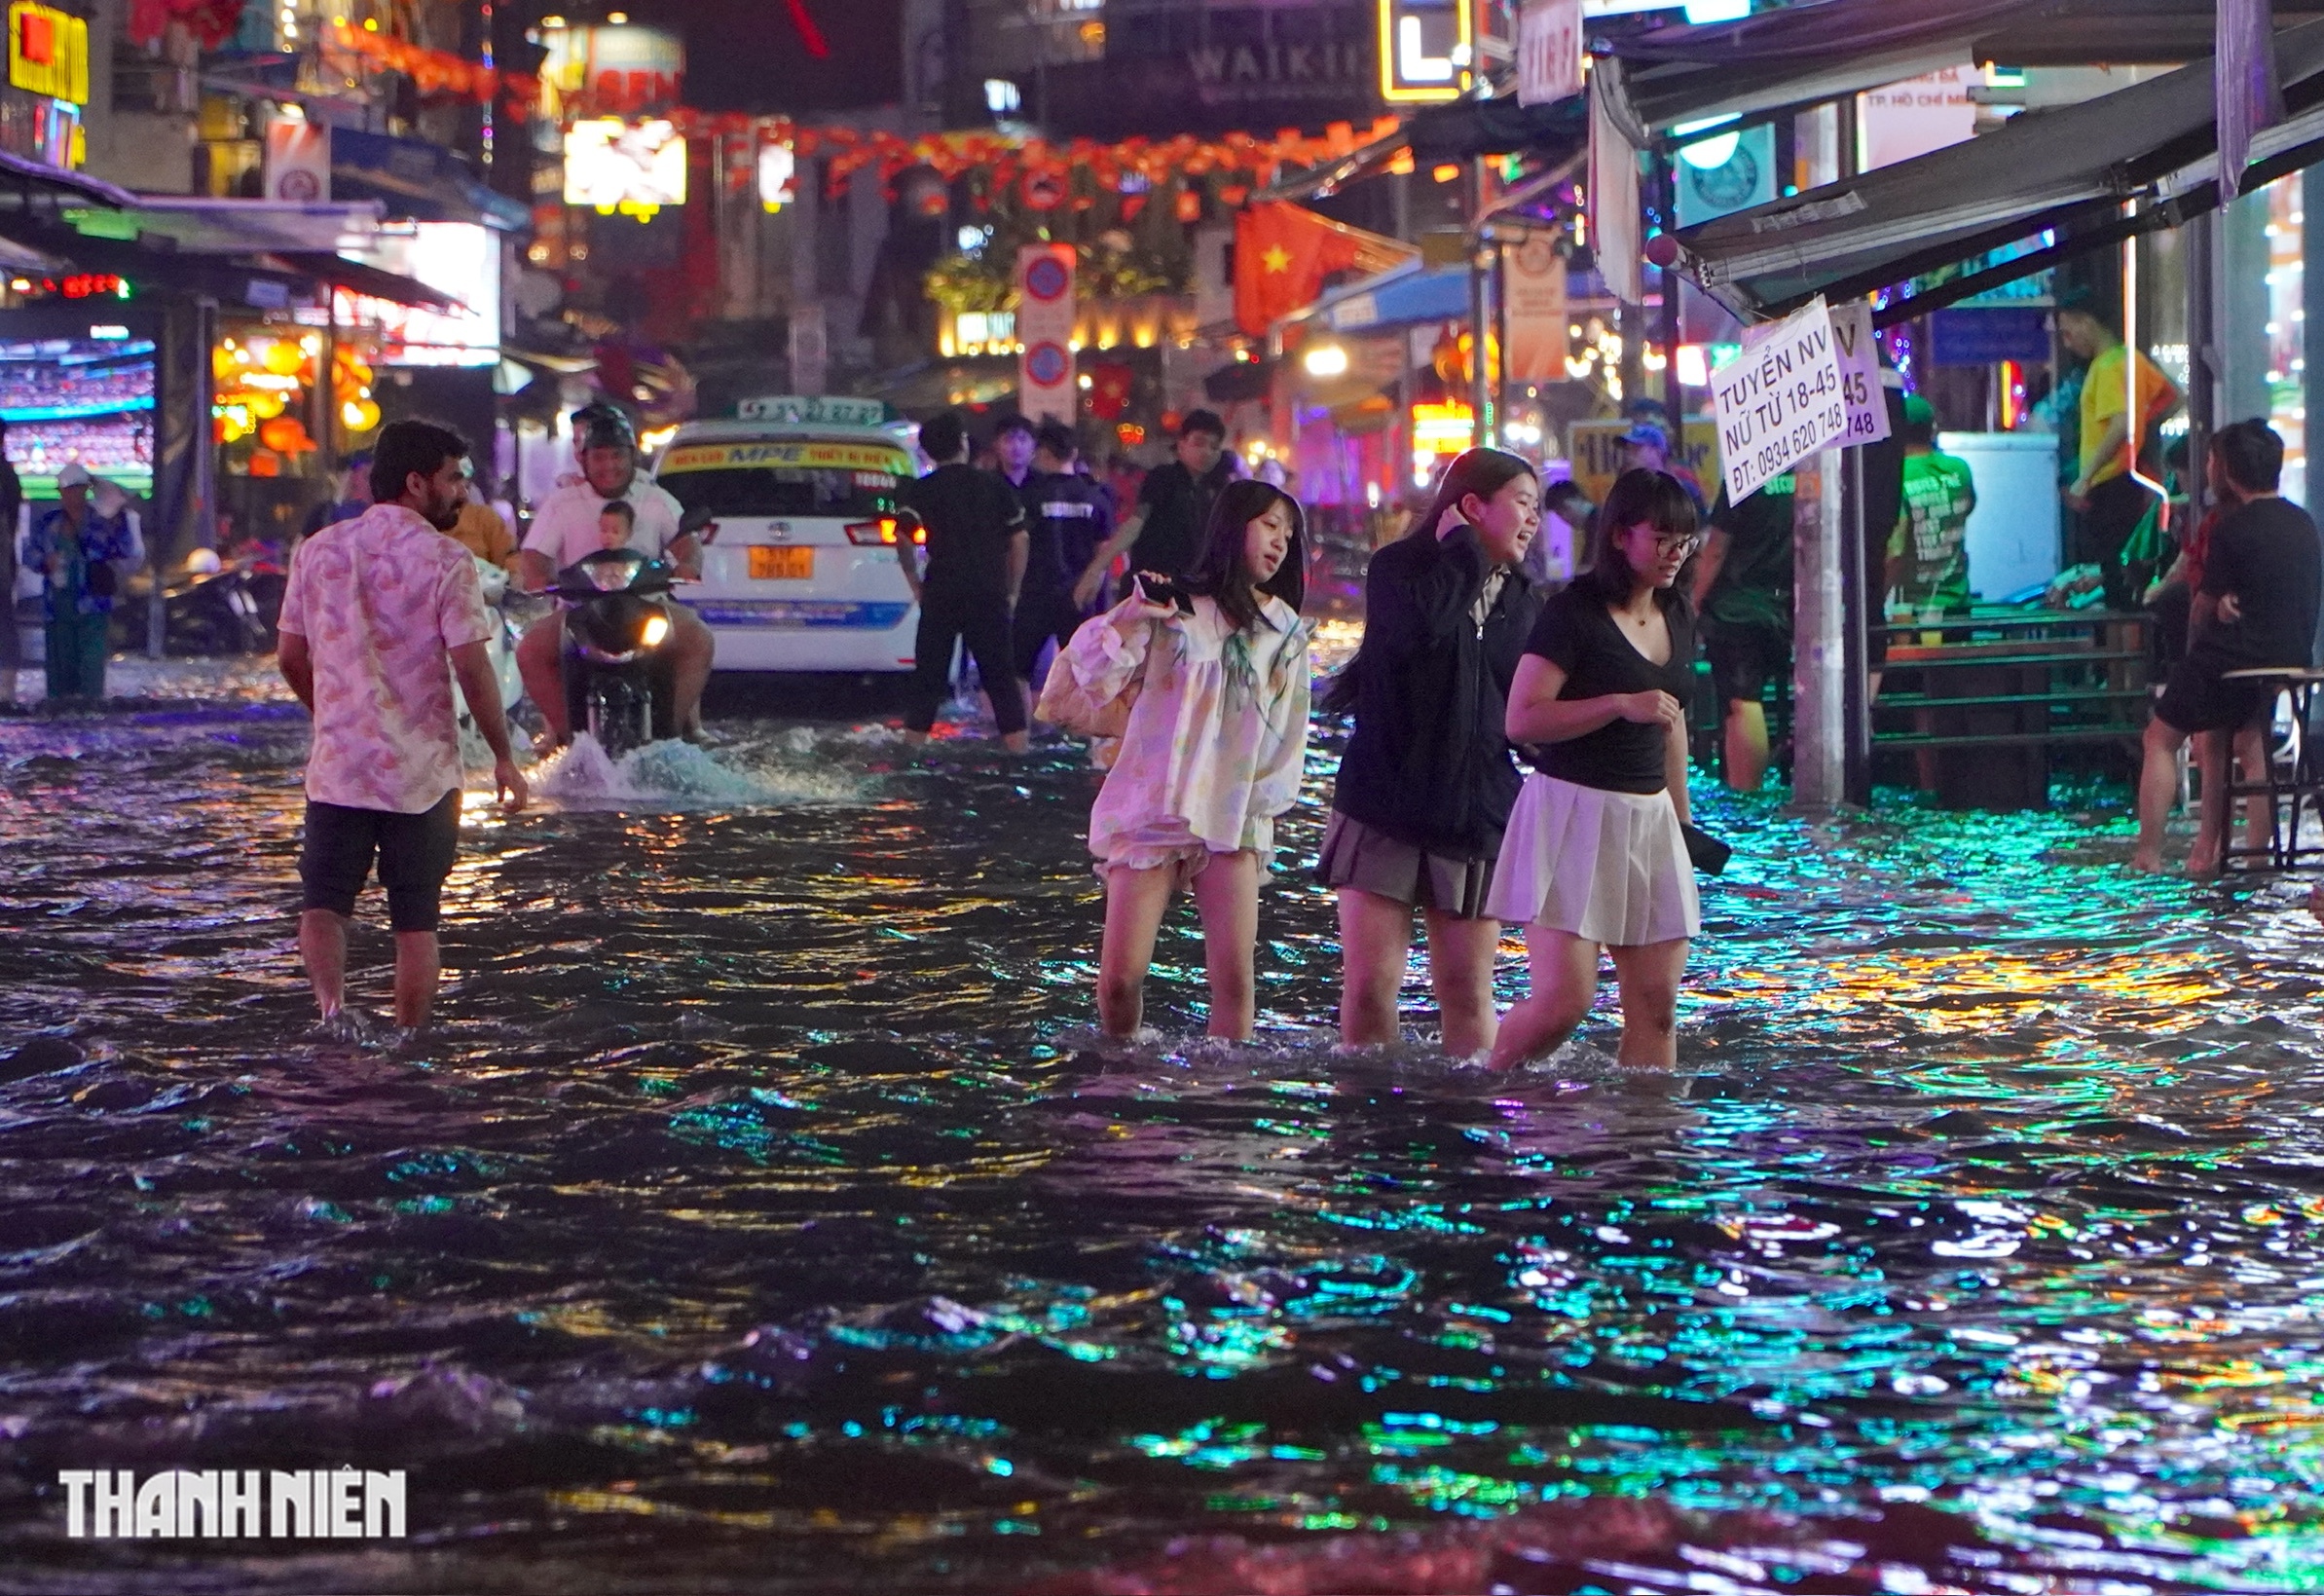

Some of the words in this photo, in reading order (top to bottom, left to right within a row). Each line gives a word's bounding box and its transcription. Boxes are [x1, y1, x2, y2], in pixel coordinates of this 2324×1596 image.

[1720, 345, 1791, 414] TUYỂN
[1798, 324, 1826, 365] NV
[1836, 323, 1856, 358] V
[1726, 410, 1752, 457] NỮ
[1755, 391, 1783, 434] TỪ
[1787, 364, 1836, 414] 18-45
[1843, 372, 1867, 406] 45
[1733, 460, 1756, 494] ĐT:
[1758, 436, 1789, 477] 0934
[1792, 420, 1817, 455] 620
[1819, 403, 1842, 437] 748
